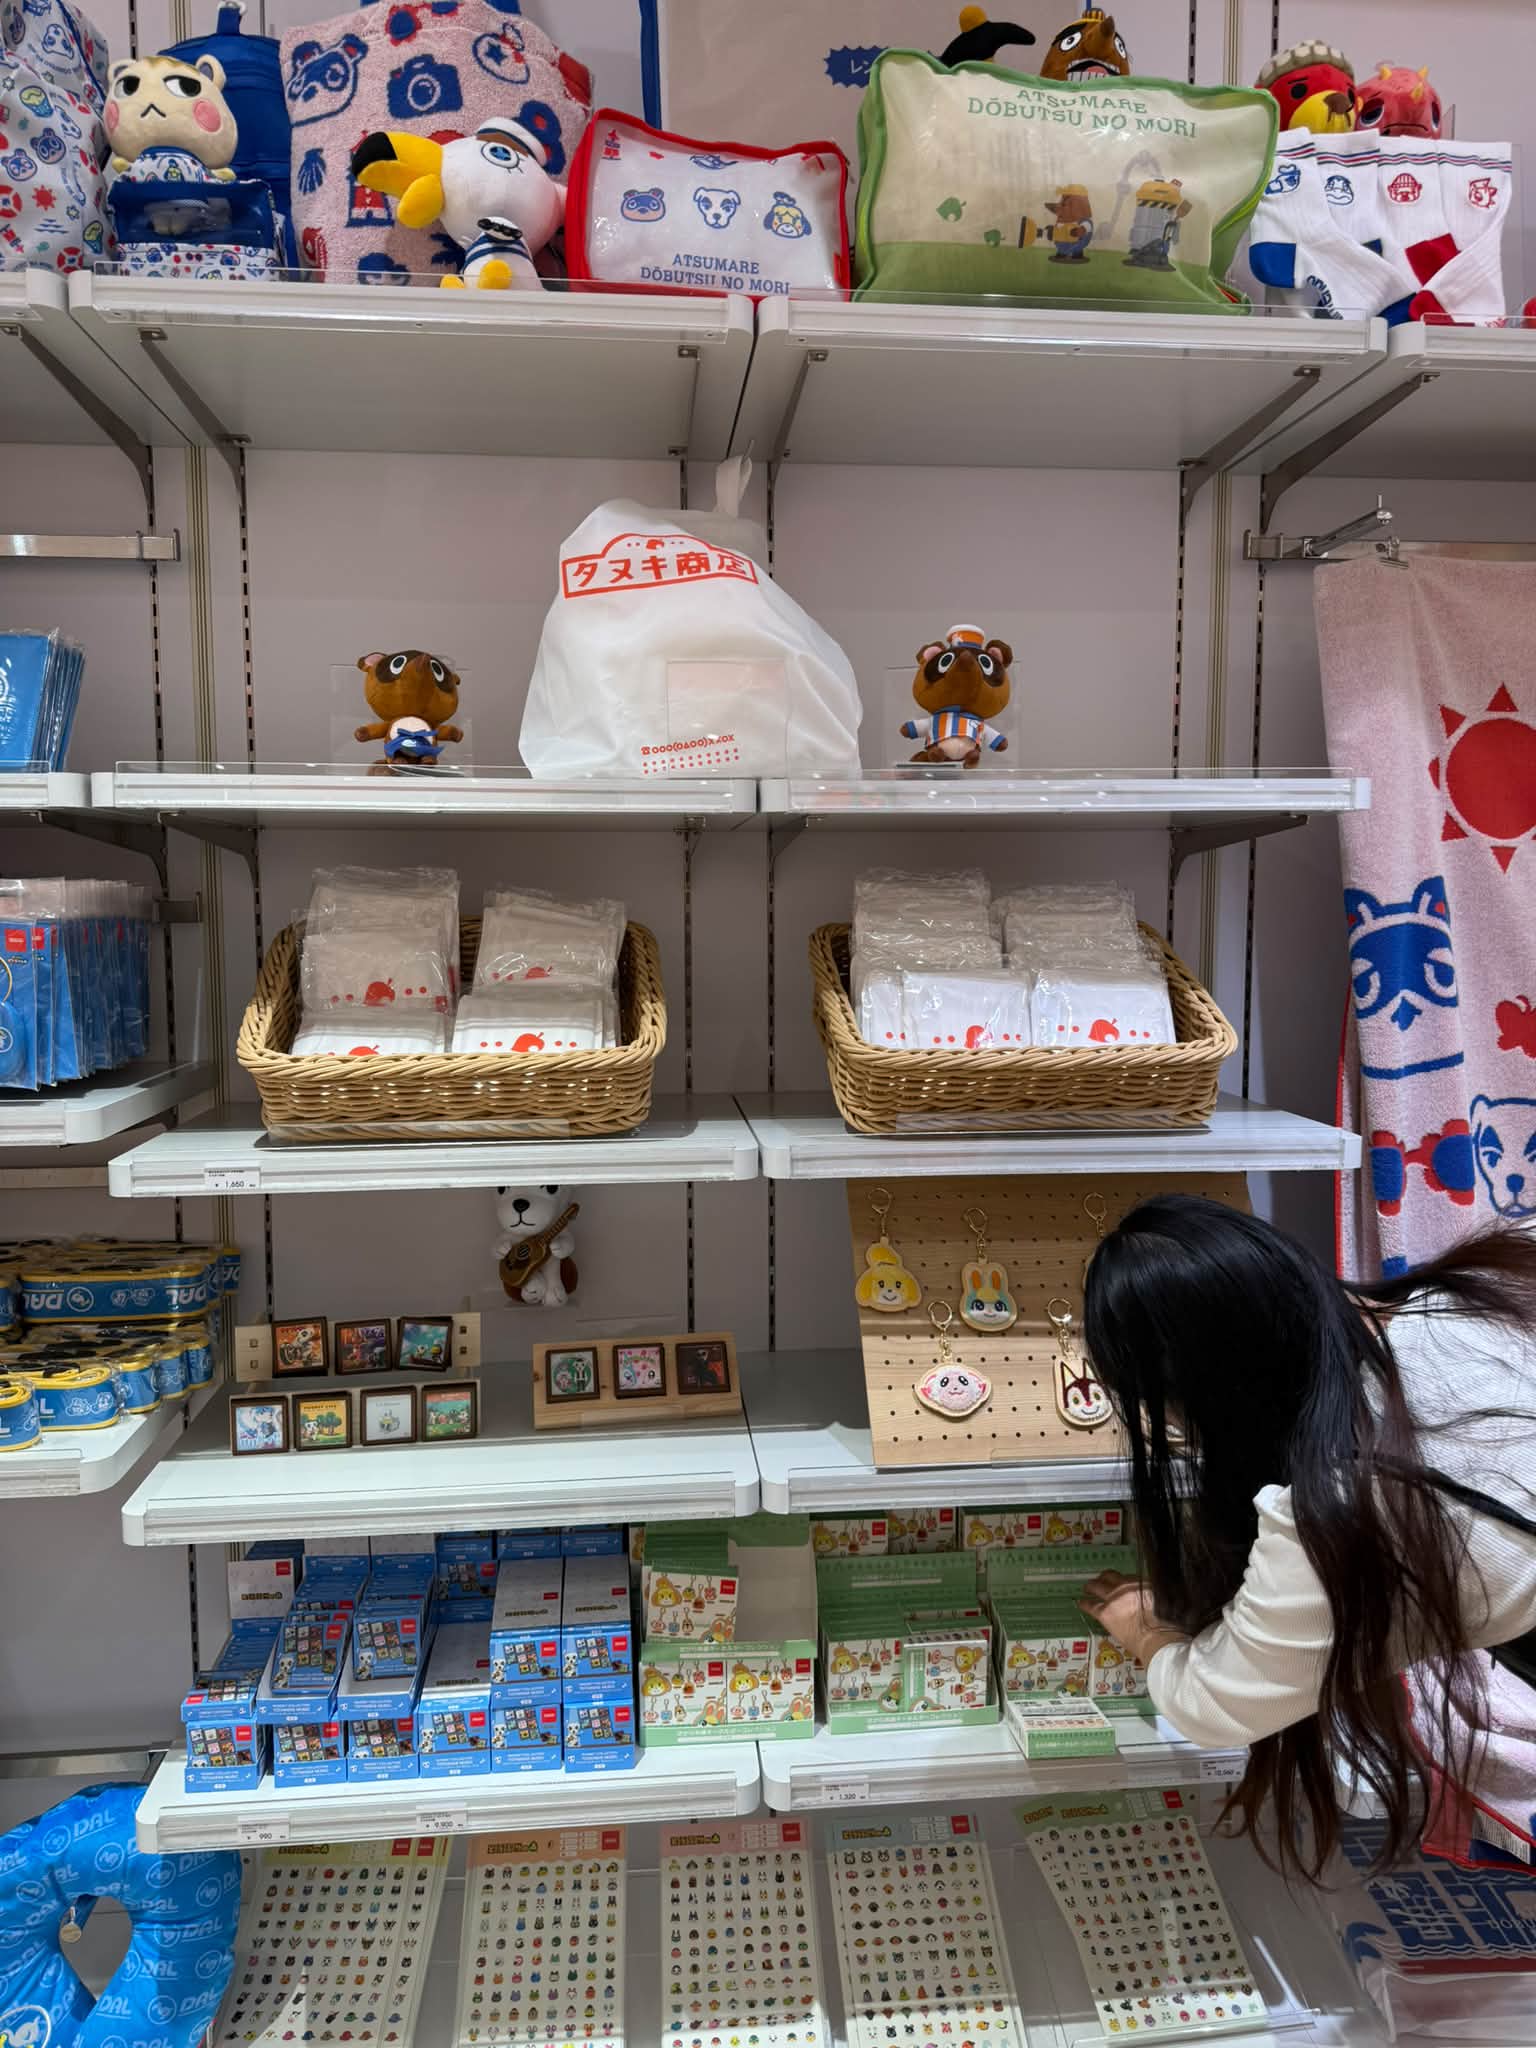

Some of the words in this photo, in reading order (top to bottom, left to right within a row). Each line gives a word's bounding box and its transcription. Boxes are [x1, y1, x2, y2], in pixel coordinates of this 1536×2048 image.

[1017, 88, 1147, 114] ATSUMARE
[1092, 113, 1127, 130] NO
[1136, 117, 1197, 138] MORI
[672, 253, 760, 274] ATSUMARE
[721, 276, 744, 290] NO
[749, 280, 790, 295] MORI
[572, 551, 747, 587] タヌキ商店
[73, 1808, 116, 1837] DAL
[182, 1917, 223, 1938] DAL
[141, 1959, 178, 1977] DAL
[99, 1994, 131, 2014] DAL
[180, 1988, 217, 2013] DAL
